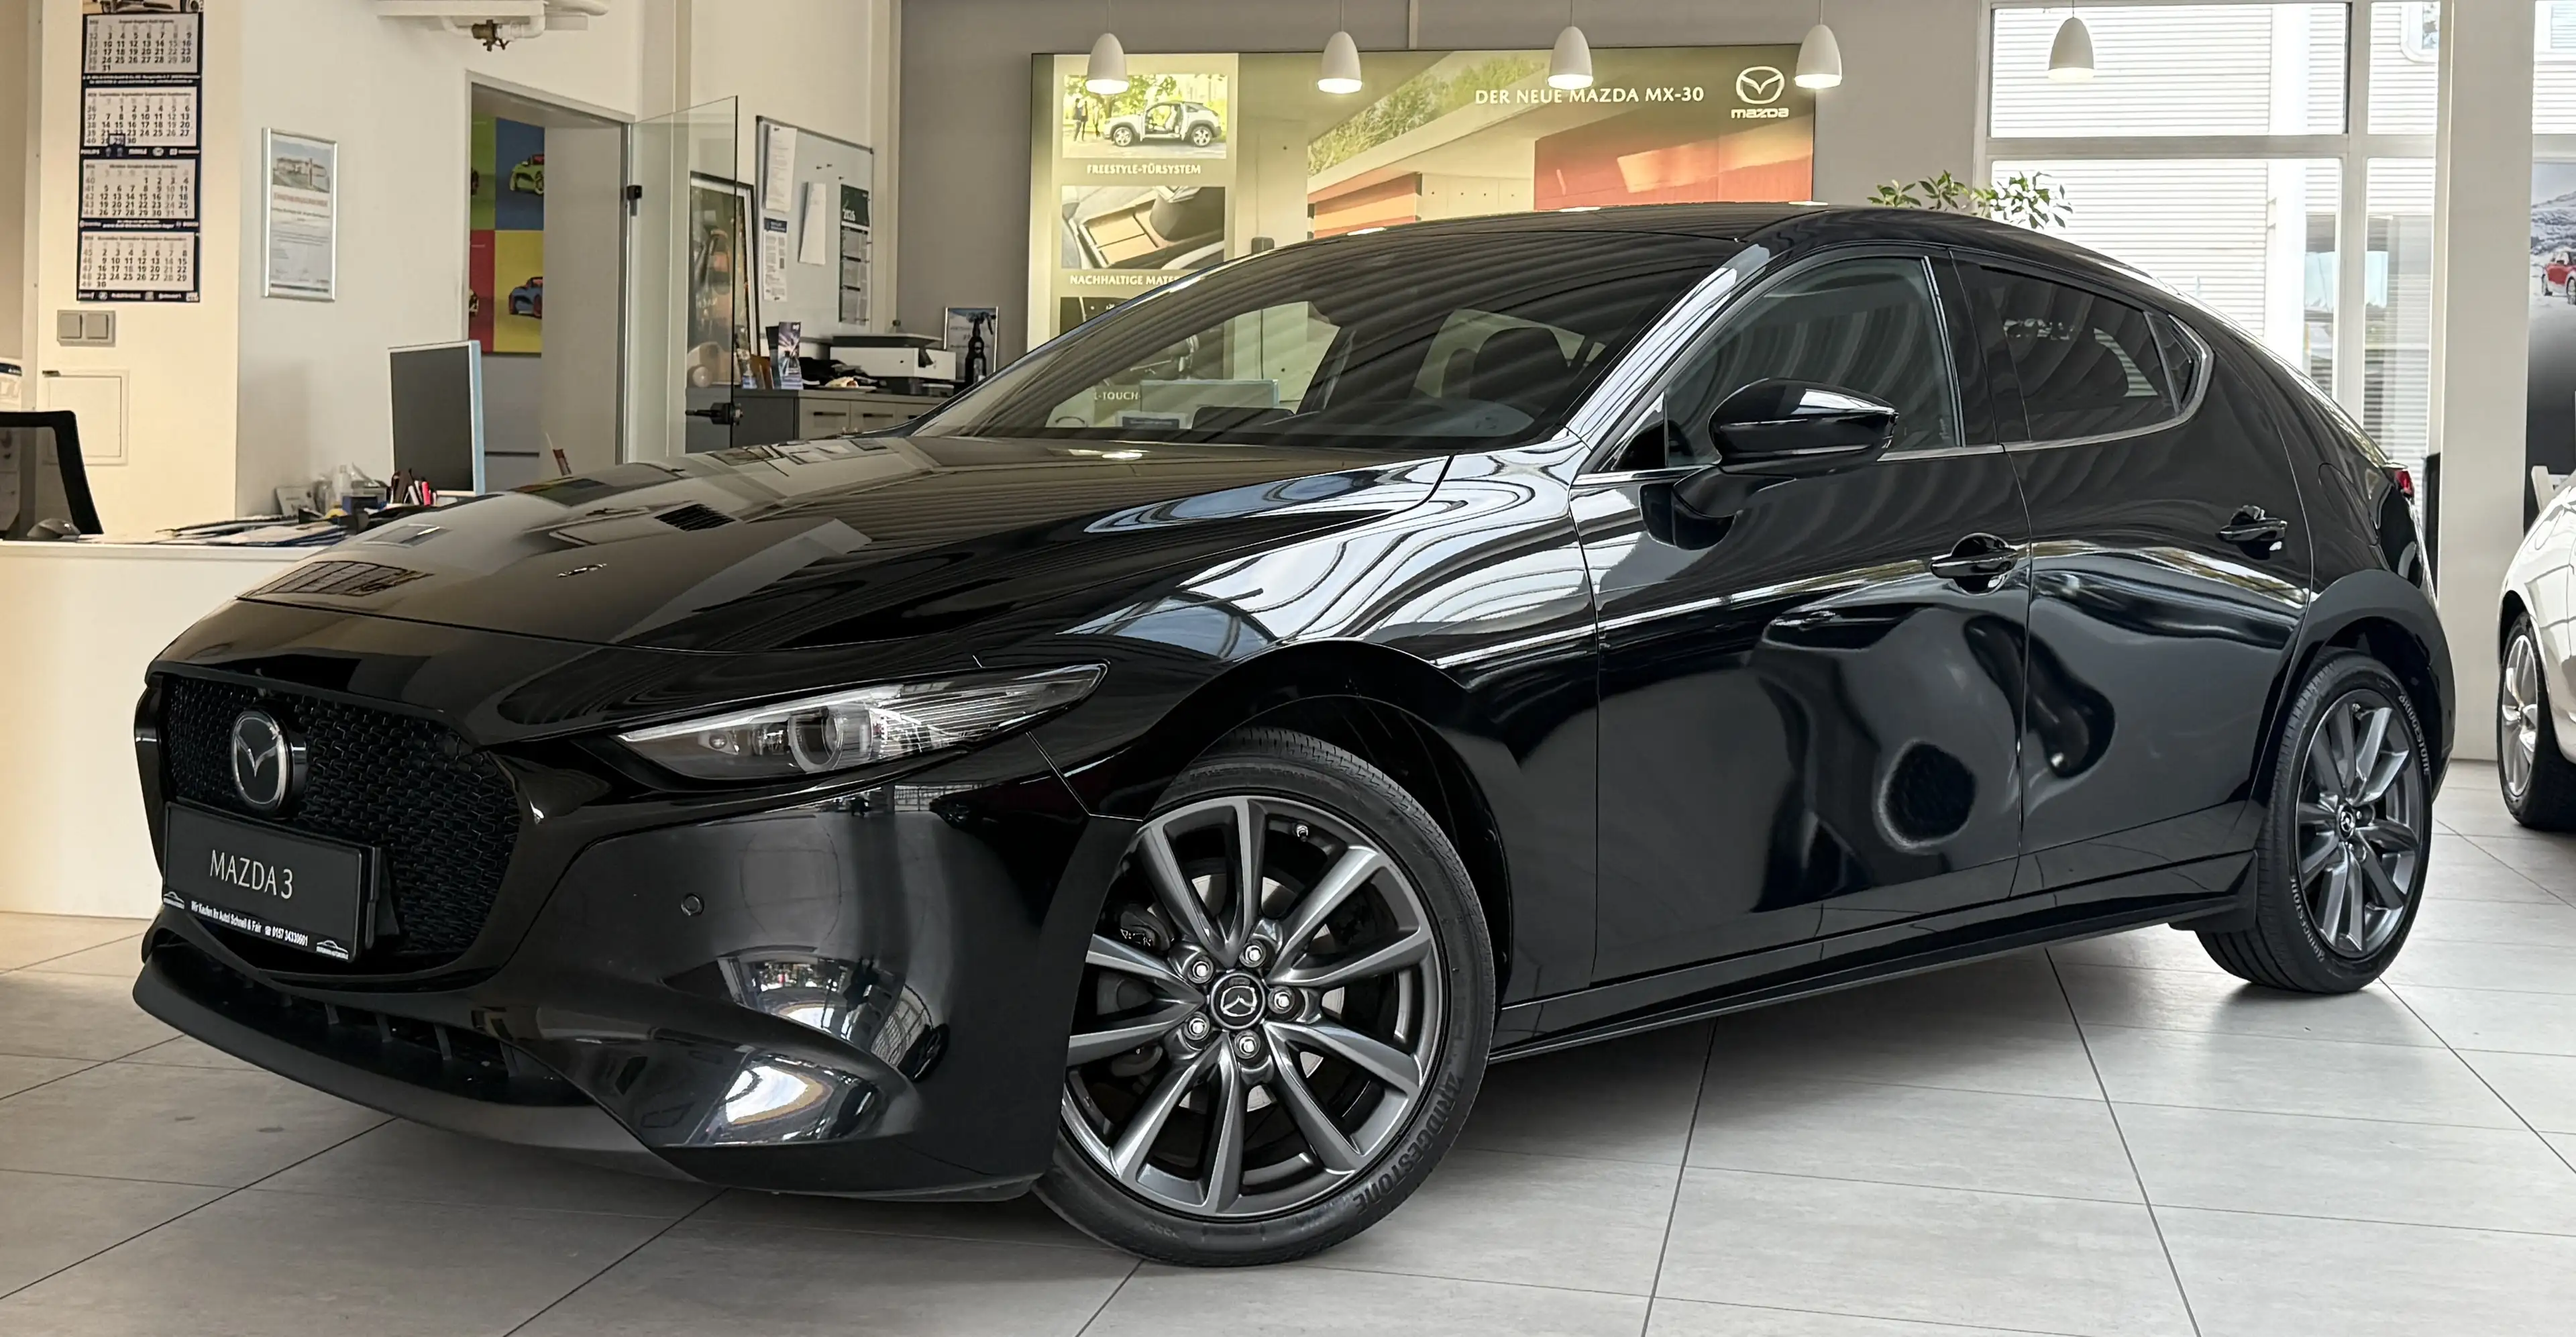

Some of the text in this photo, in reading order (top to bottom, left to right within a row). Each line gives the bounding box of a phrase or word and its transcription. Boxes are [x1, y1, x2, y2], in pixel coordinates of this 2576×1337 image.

[1475, 87, 1704, 105] DER NEUE MAZDA MX-30
[1087, 163, 1201, 174] FREESTYLE-TÜRSYSTEM
[1070, 275, 1143, 285] NACHHALTIGE
[252, 920, 262, 933] Fair
